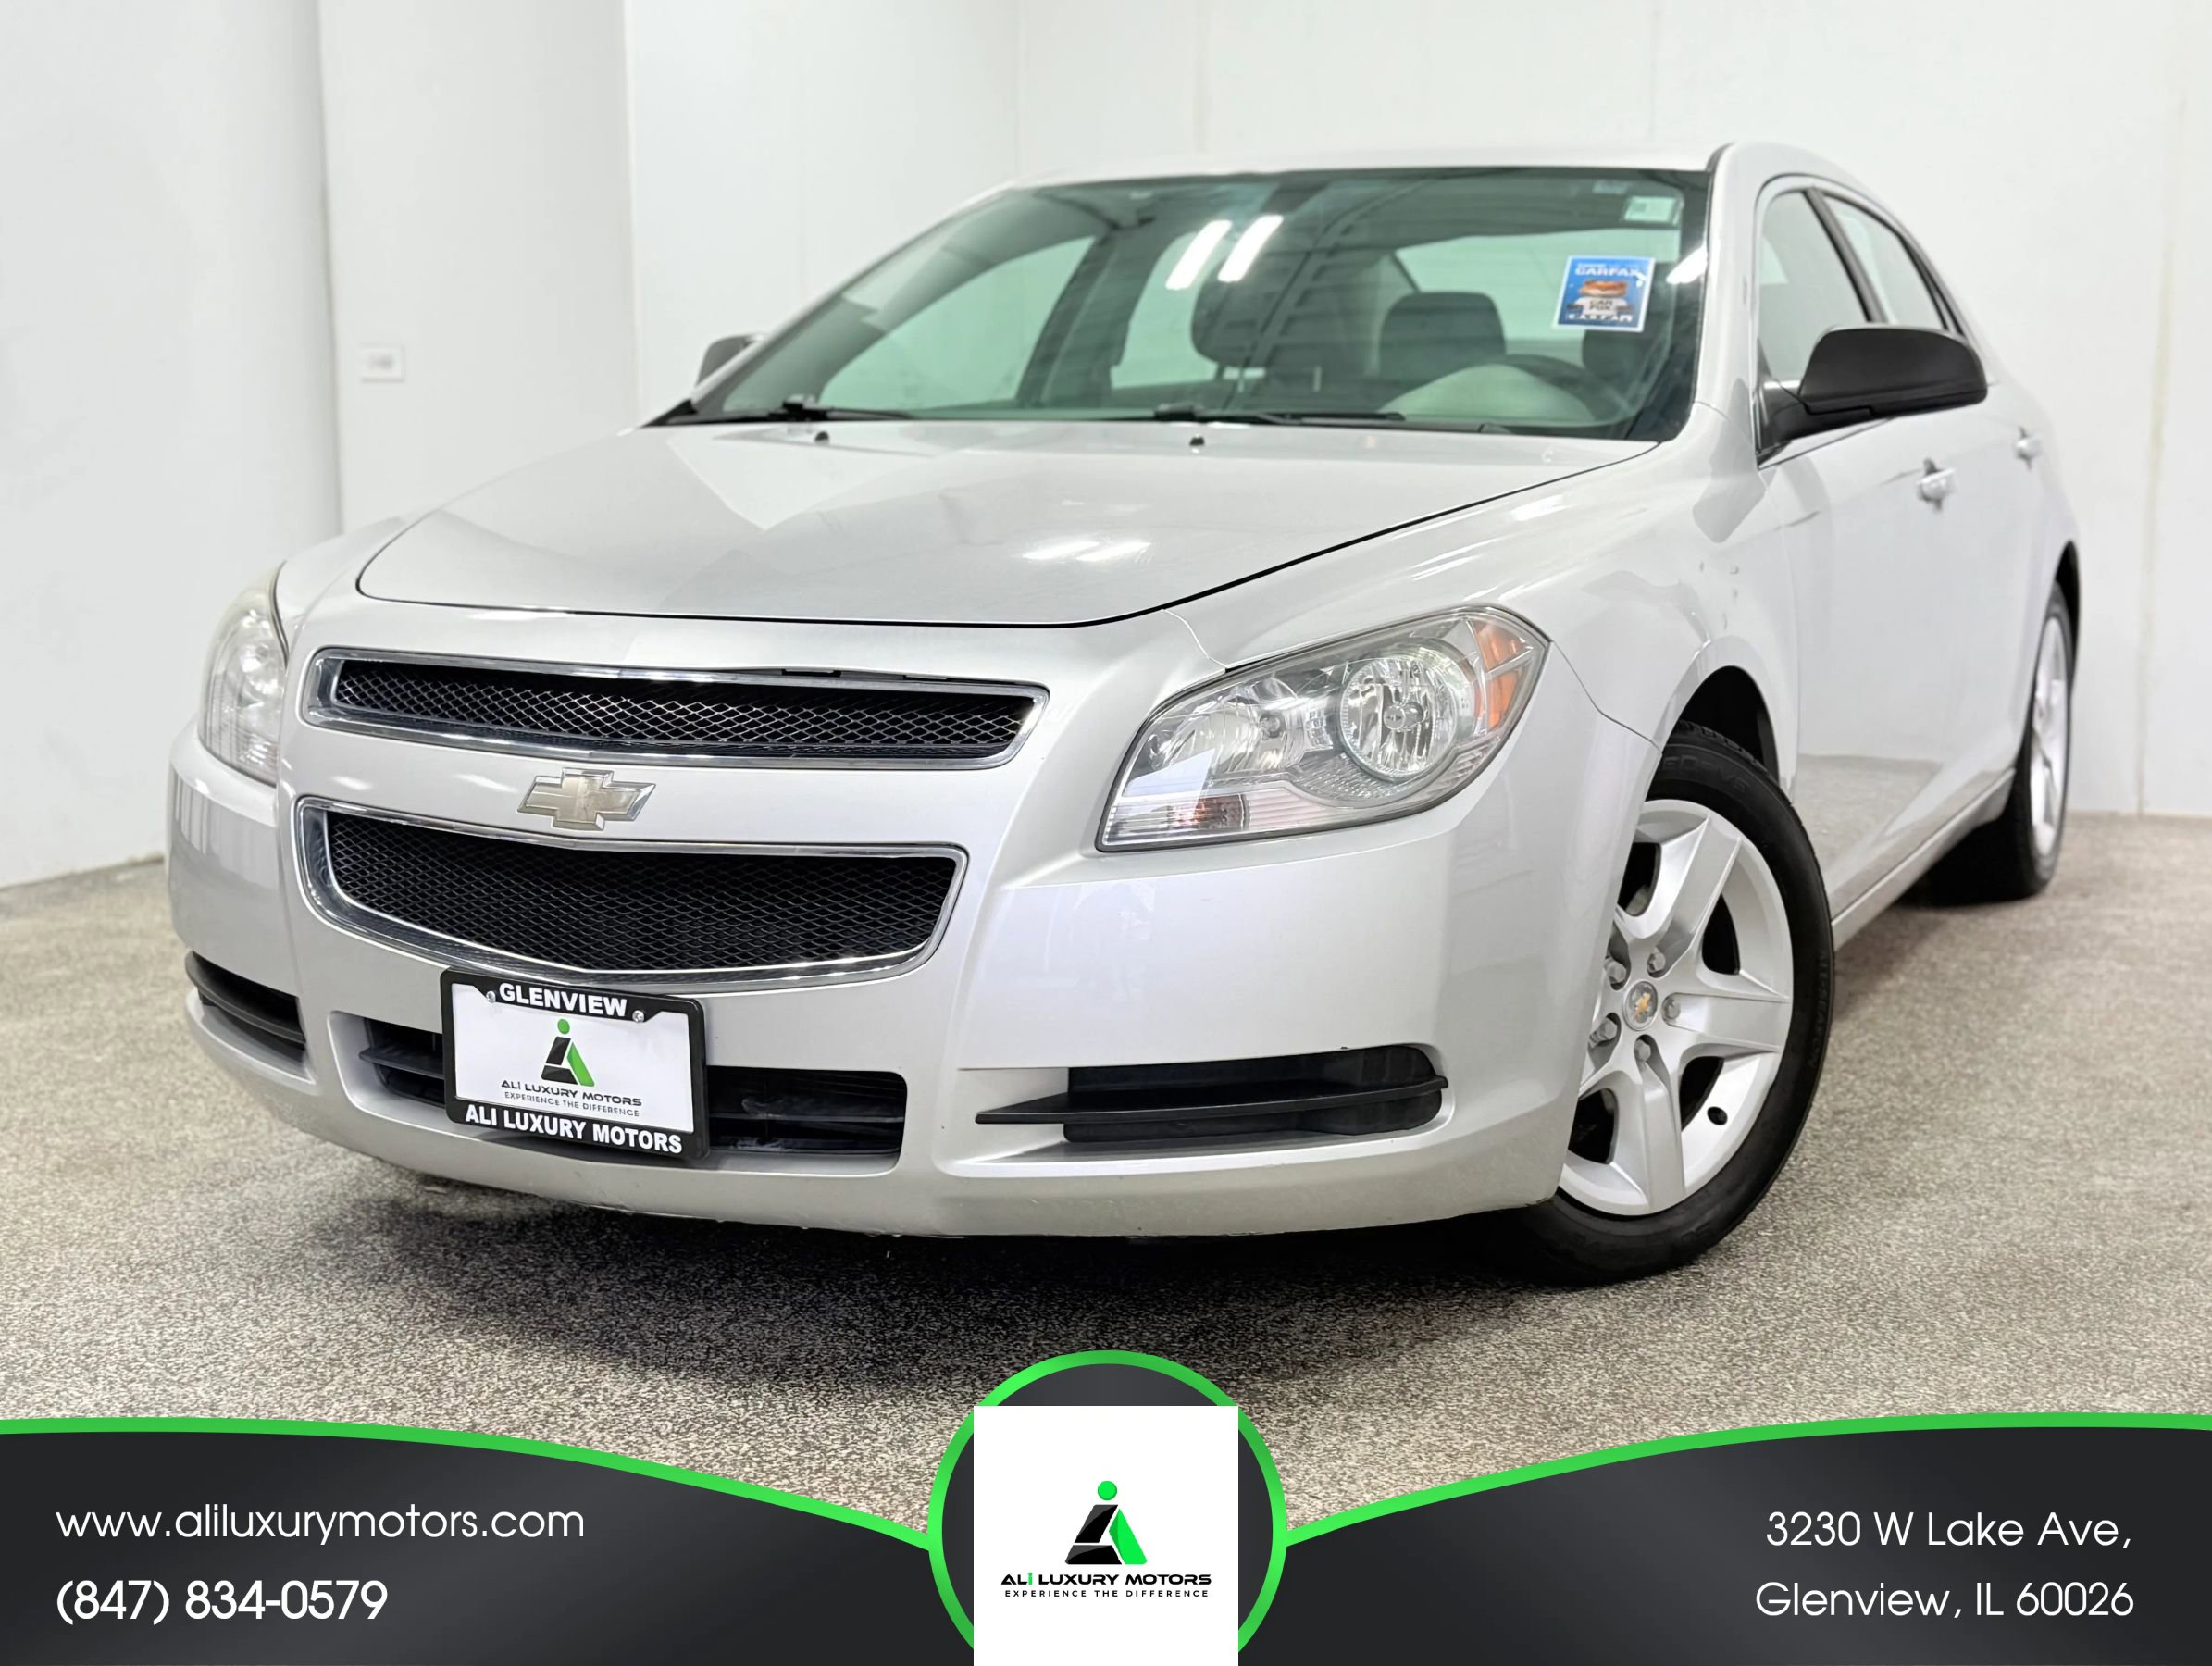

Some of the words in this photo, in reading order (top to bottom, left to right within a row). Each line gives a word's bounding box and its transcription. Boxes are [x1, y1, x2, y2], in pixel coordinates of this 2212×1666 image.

[499, 983, 627, 1017] GLENVIEW
[501, 1079, 521, 1090] ALI
[525, 1083, 578, 1099] LUXURY
[582, 1091, 642, 1107] MOTORS
[504, 1091, 560, 1106] EXPERIENCE
[563, 1100, 579, 1109] THE
[582, 1103, 640, 1117] DIFFERENCE
[466, 1104, 497, 1126] ALI
[503, 1110, 587, 1139] LUXURY
[592, 1123, 683, 1154] MOTORS
